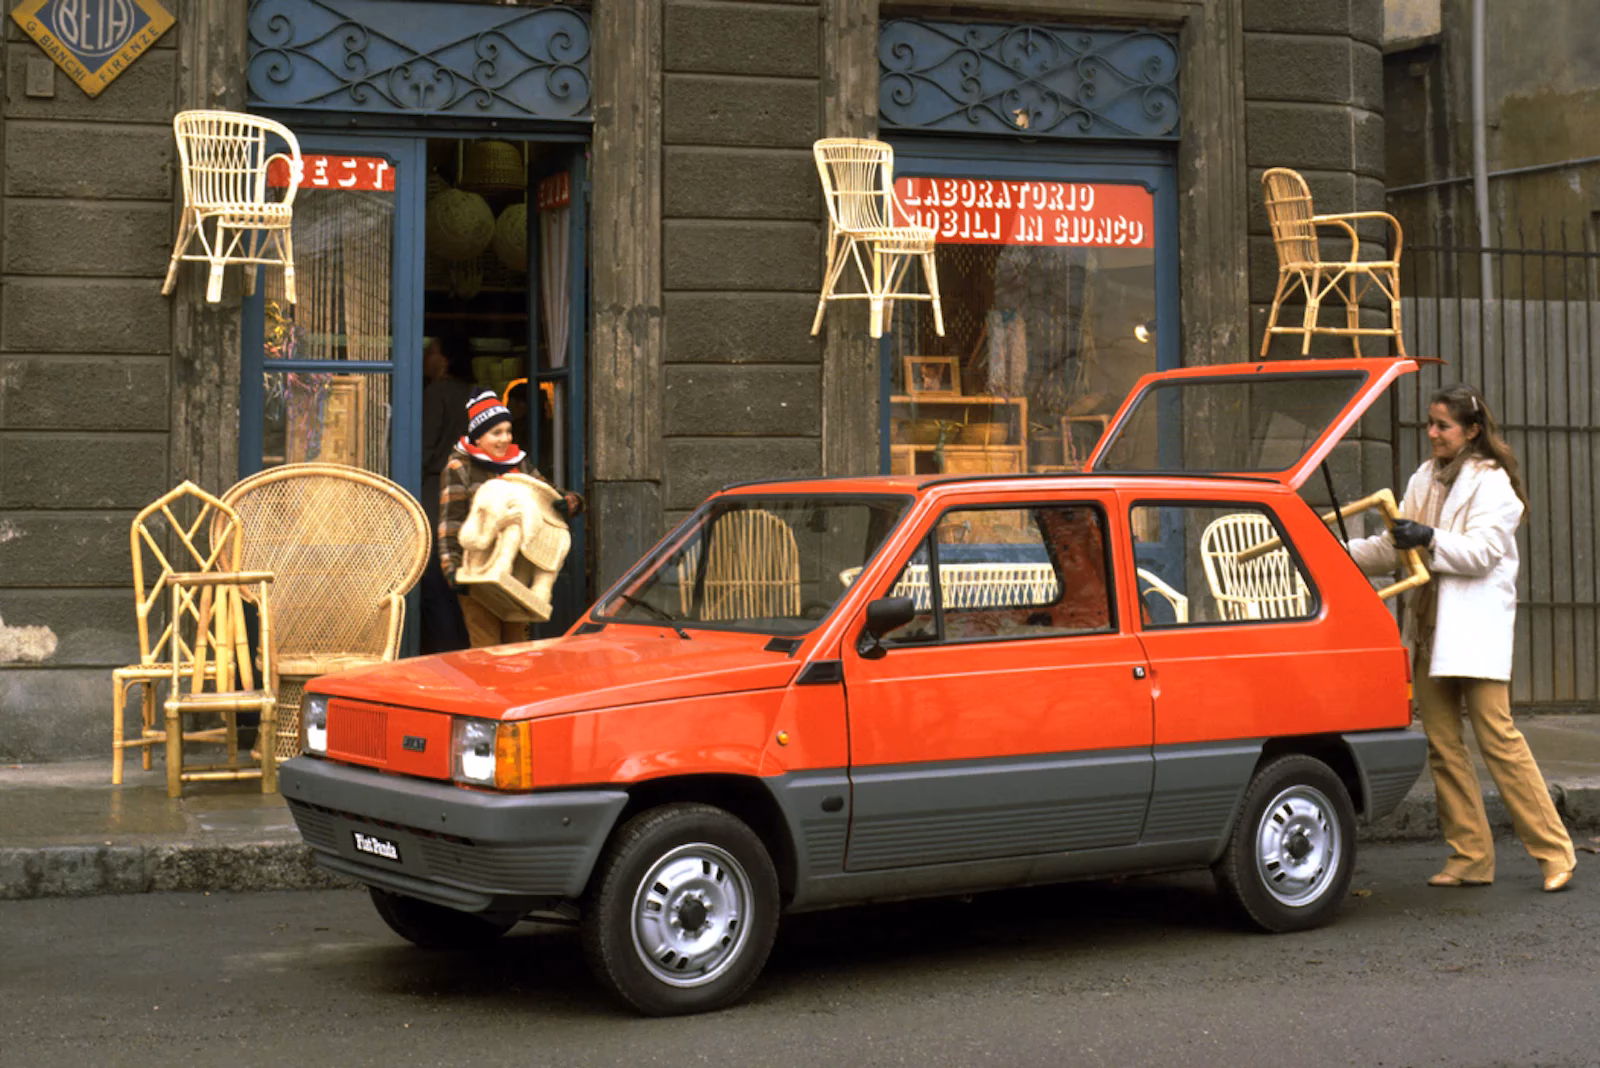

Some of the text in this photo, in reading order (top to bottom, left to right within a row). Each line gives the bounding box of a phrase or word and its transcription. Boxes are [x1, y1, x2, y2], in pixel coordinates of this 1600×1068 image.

[39, 34, 87, 81] BIANCHI
[98, 26, 160, 83] FIRENZE
[903, 178, 1095, 213] LABORATORIO
[1014, 213, 1044, 243] IN
[1053, 213, 1144, 245] GIUNCO
[354, 832, 398, 860] Fiat Panda
